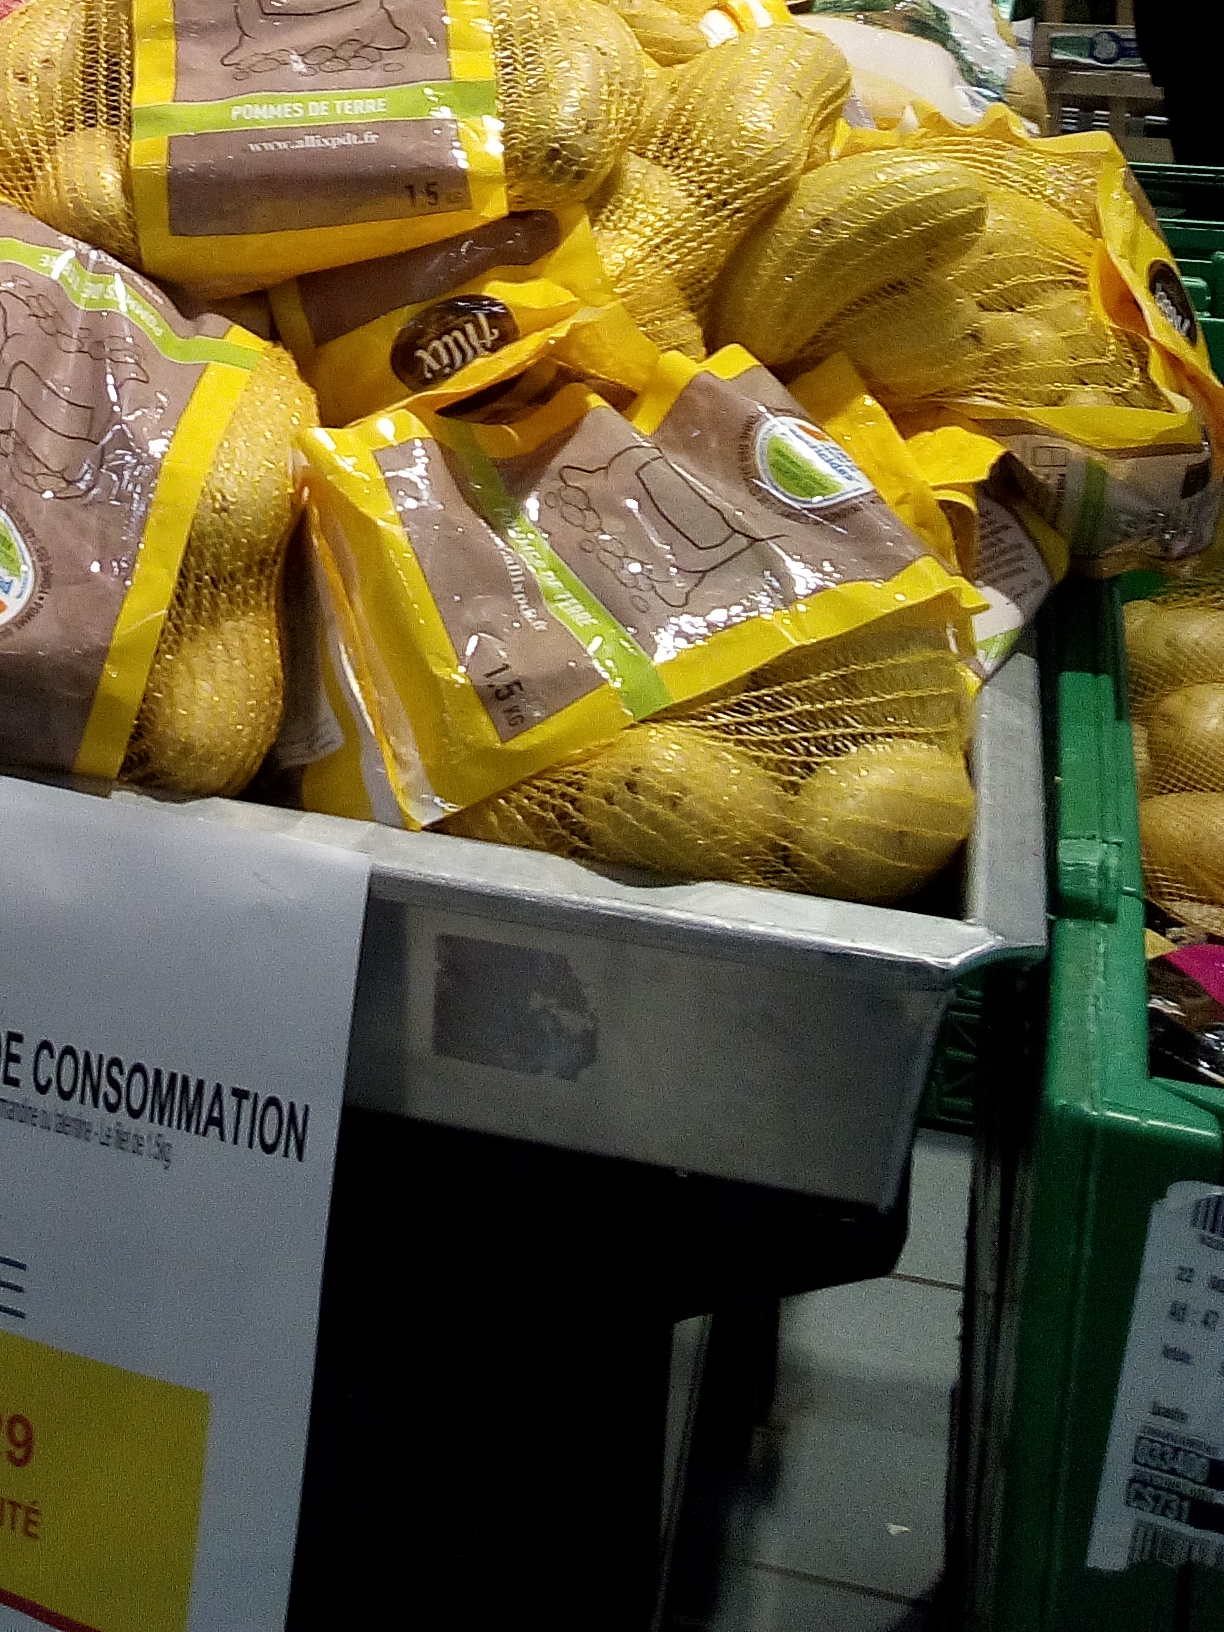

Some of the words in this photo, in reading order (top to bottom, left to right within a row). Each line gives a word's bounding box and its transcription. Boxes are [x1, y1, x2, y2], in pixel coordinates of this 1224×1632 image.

[231, 101, 305, 121] POMMES
[307, 100, 330, 116] DE
[333, 98, 388, 115] TERRE
[32, 1039, 310, 1163] CONSOMMATION
